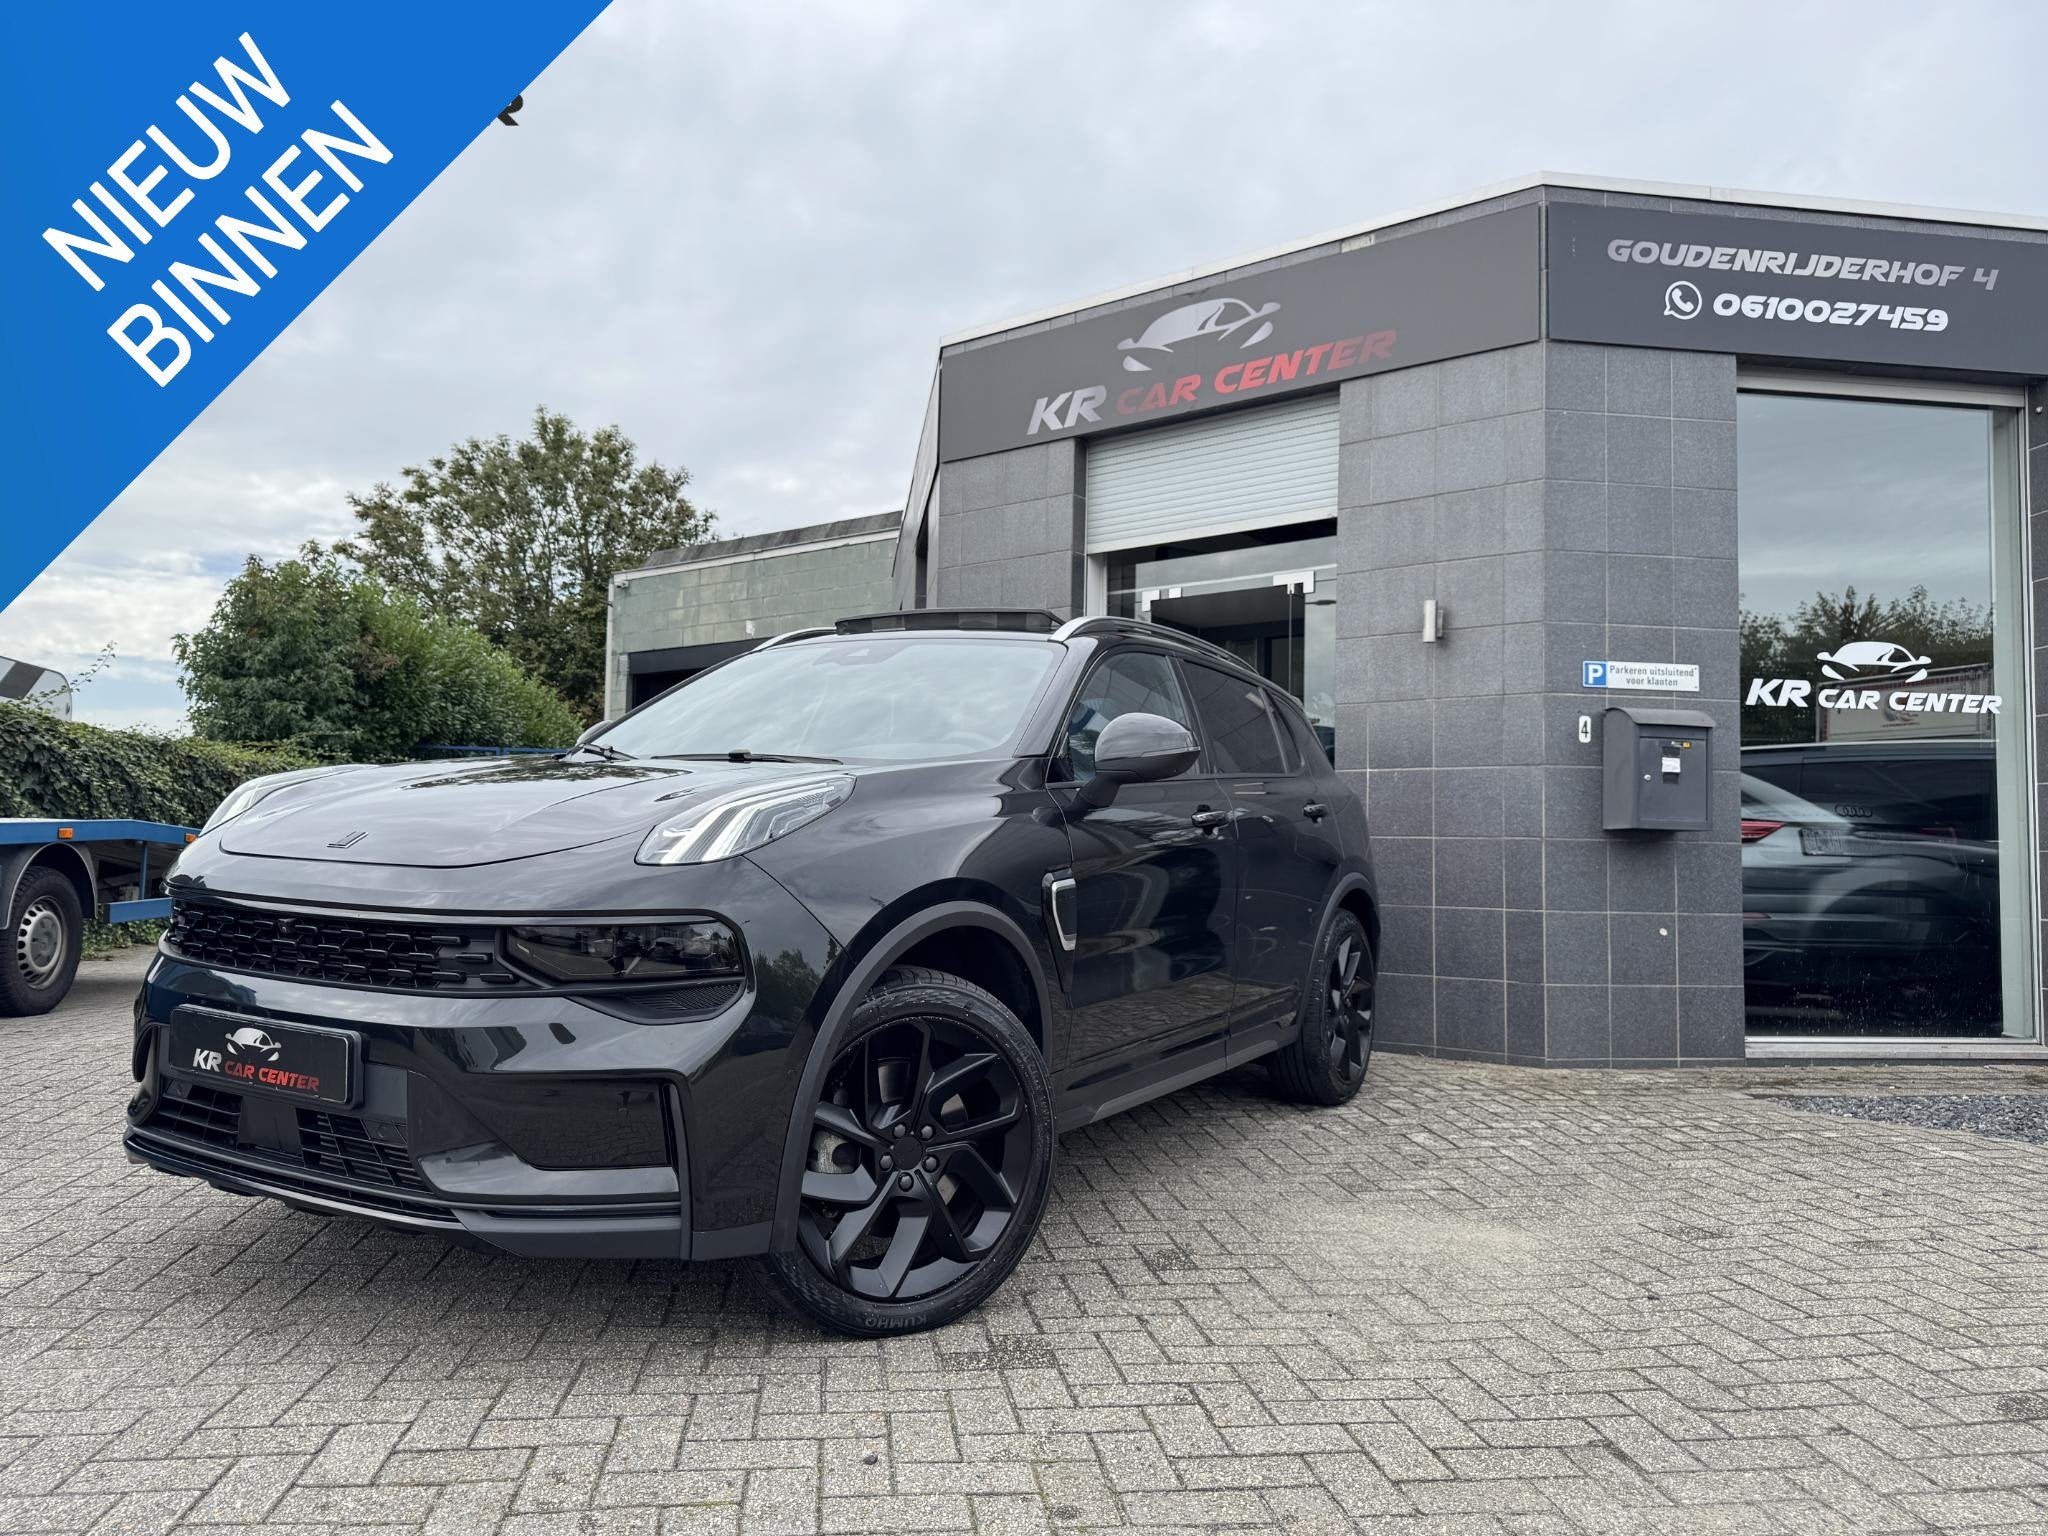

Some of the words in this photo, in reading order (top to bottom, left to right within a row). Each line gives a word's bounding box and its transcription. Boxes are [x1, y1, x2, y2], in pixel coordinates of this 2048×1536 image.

[1607, 239, 1965, 287] GOUDENRIJDERHOF
[1973, 268, 2000, 290] 4
[1713, 293, 1949, 332] 0610027459
[1027, 385, 1107, 435] KR
[1116, 374, 1201, 415] CAR
[1214, 329, 1397, 394] CENTER
[1588, 664, 1603, 684] P
[1609, 665, 1647, 675] Parkeren
[1649, 666, 1694, 677] uitsluitend
[1647, 677, 1678, 687] klanten
[1745, 678, 1812, 708] KR
[1818, 688, 1880, 710] CAR
[1888, 691, 2003, 714] CENTER
[1581, 720, 1590, 738] 4
[192, 1048, 222, 1072] KR
[224, 1060, 254, 1080] CAR
[258, 1067, 320, 1092] CENTER
[864, 1313, 927, 1329] KUMHO
